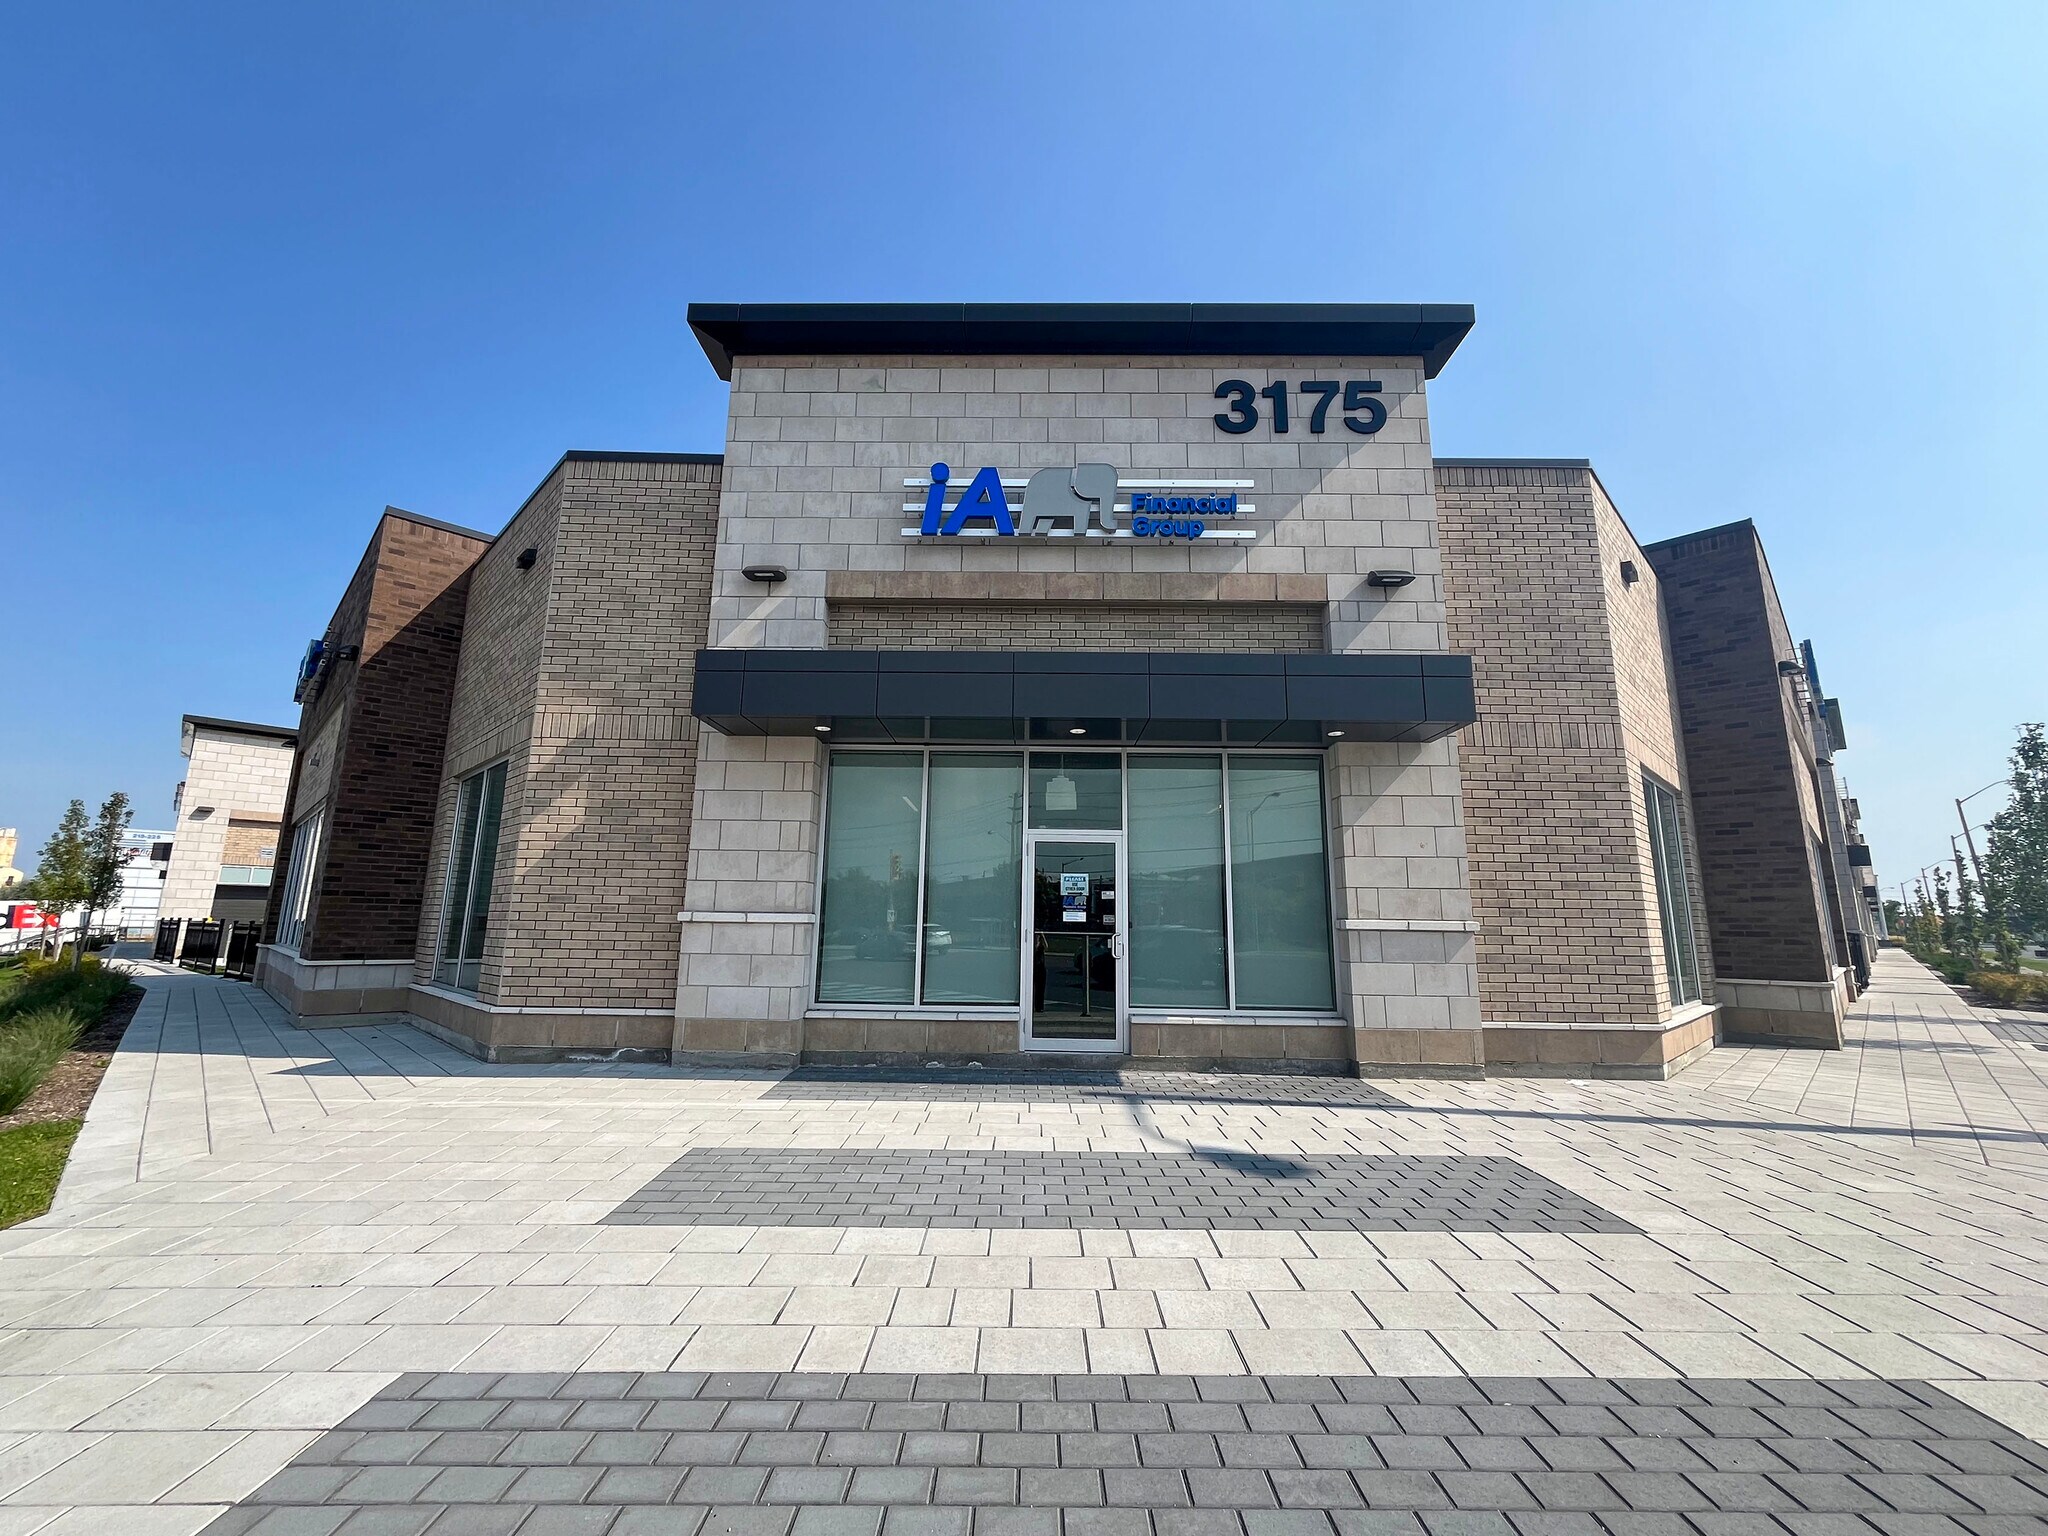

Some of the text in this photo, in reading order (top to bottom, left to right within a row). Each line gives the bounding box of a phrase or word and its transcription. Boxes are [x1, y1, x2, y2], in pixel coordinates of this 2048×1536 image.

[1213, 378, 1388, 434] 3175
[920, 461, 1015, 536] iA
[1131, 492, 1238, 515] Financial
[1131, 516, 1205, 541] Group
